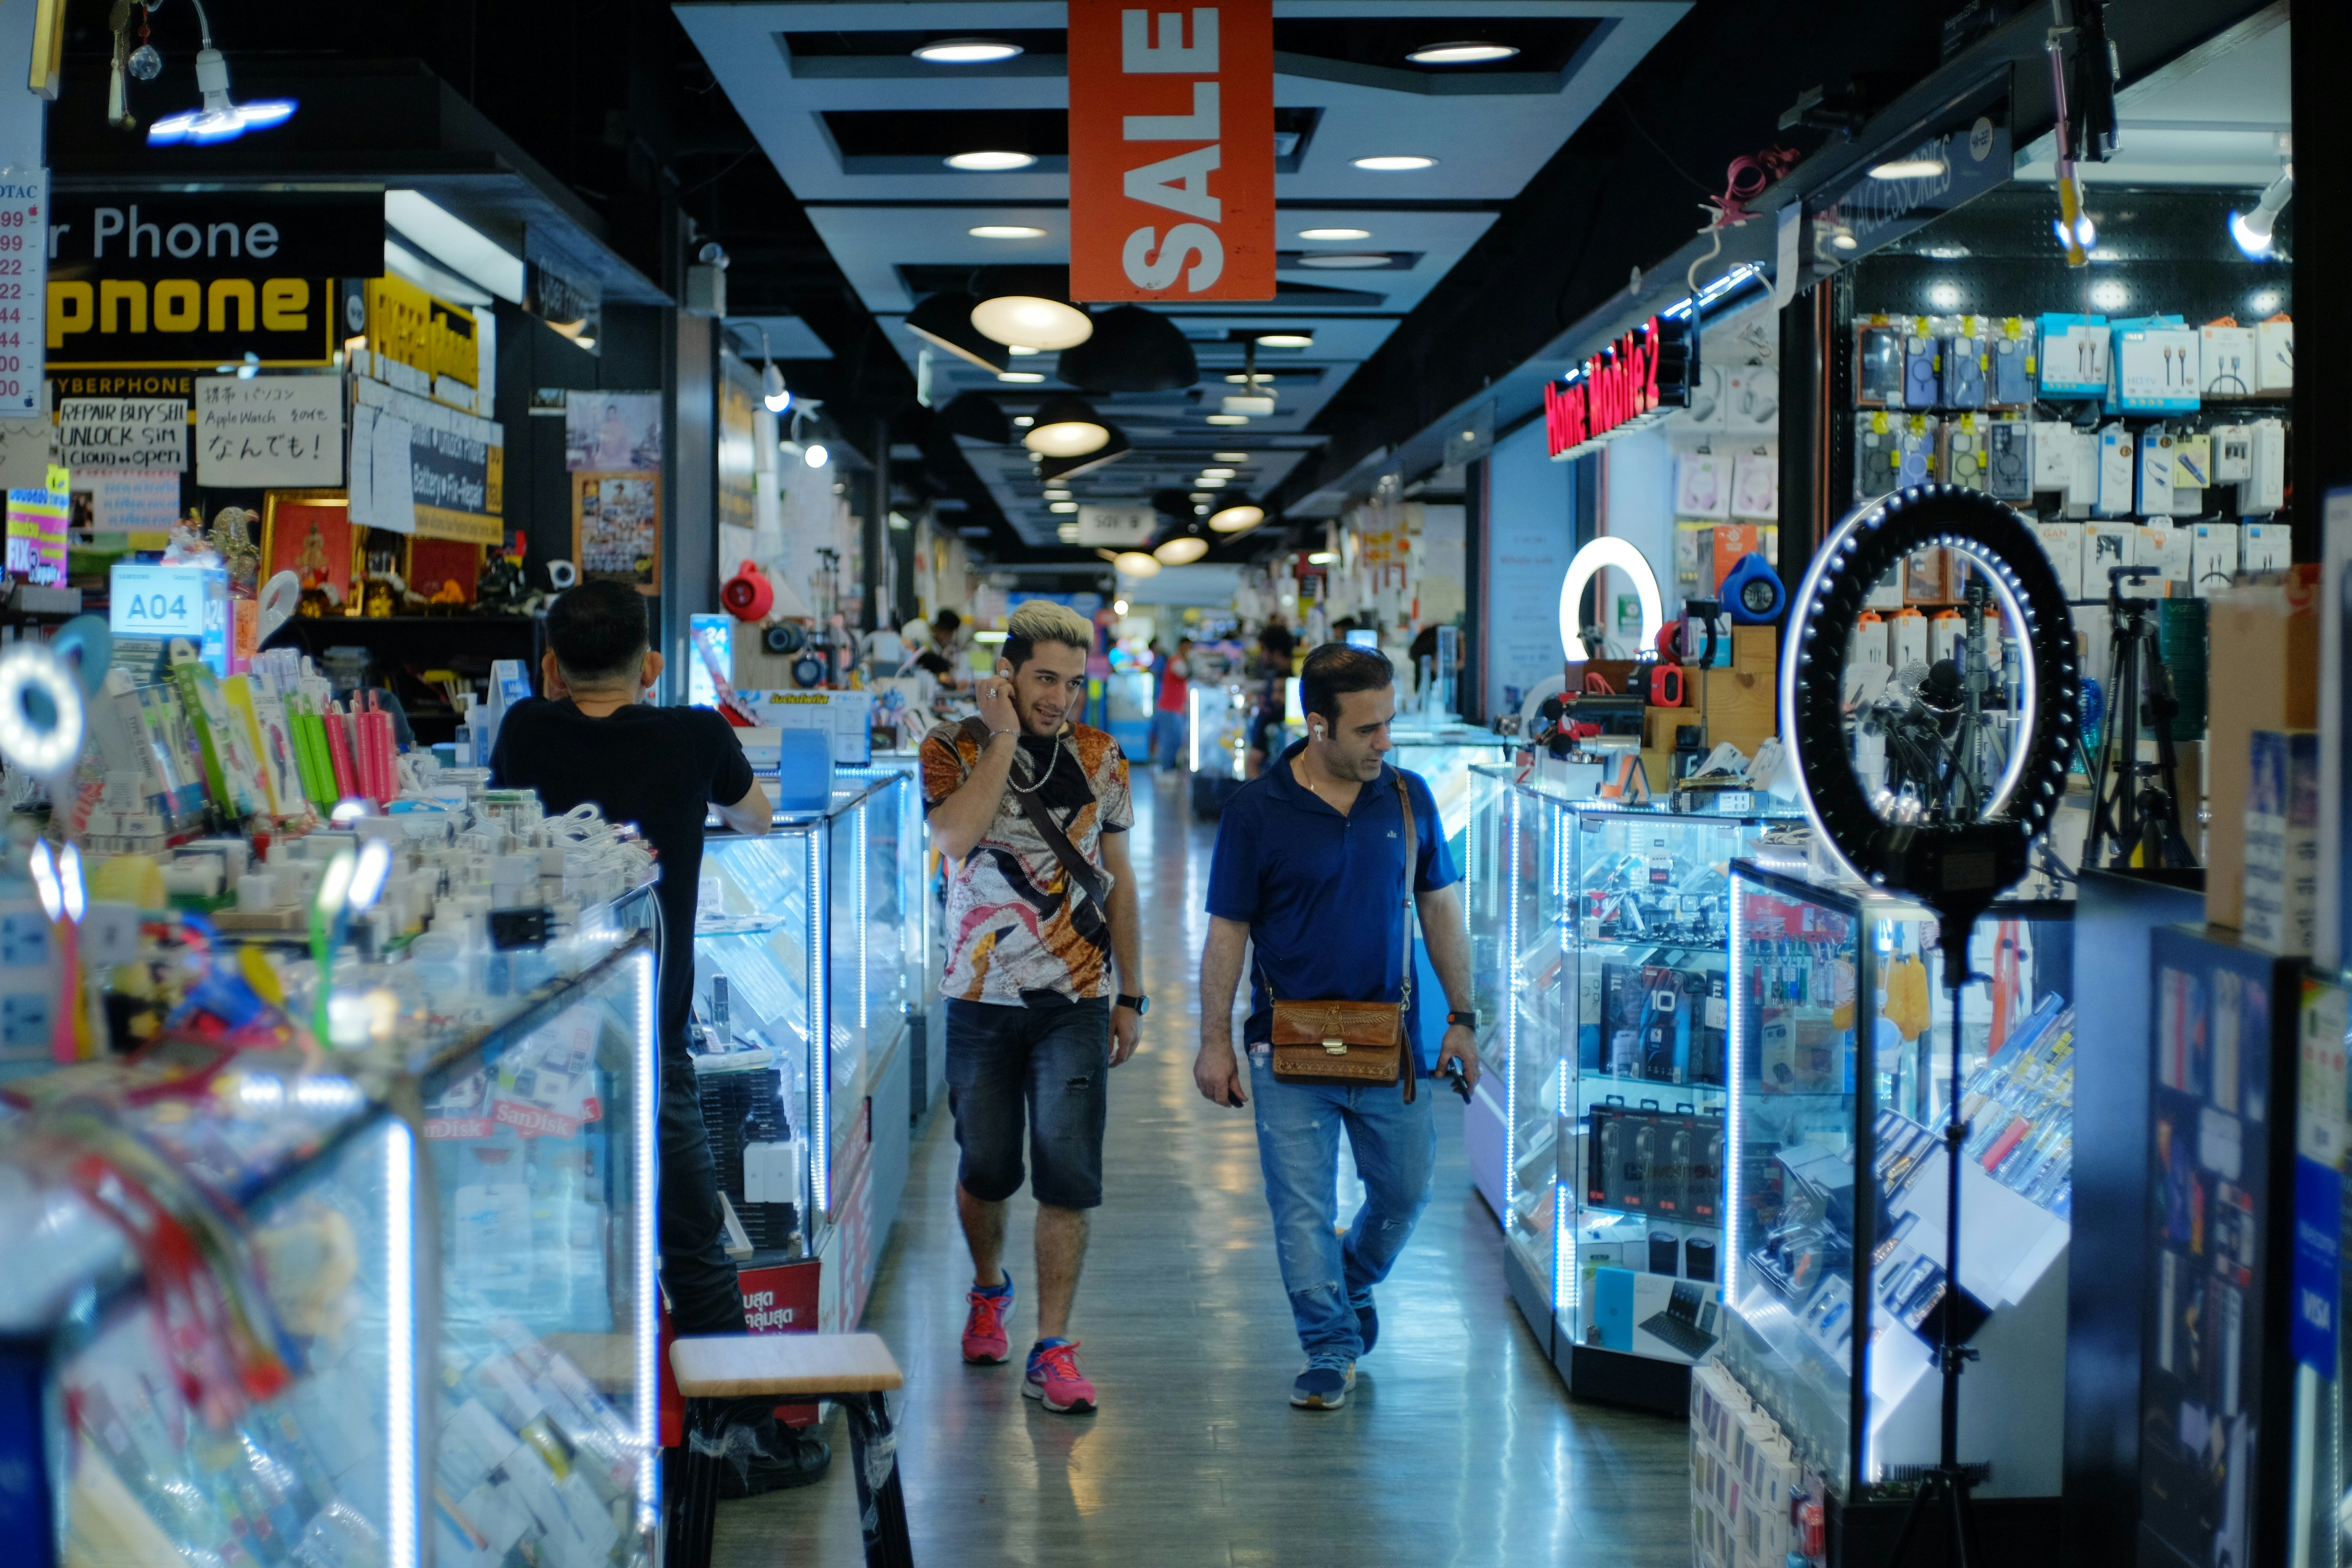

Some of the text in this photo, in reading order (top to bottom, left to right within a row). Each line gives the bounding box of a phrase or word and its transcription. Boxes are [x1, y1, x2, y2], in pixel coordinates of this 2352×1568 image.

[1122, 7, 1224, 292] SALE
[95, 205, 279, 258] Phone
[57, 377, 191, 393] YBERPHONE
[61, 403, 116, 421] REPAIR
[121, 403, 155, 423] BUY
[205, 409, 237, 429] Apple
[240, 409, 276, 424] Watch
[60, 426, 133, 446] UNLOCK
[7, 538, 31, 571] FIX
[127, 594, 187, 620] A04
[706, 626, 727, 645] 24
[1651, 990, 1675, 1012] 10
[424, 1120, 484, 1138] nDisk
[497, 1104, 569, 1136] SanDisk
